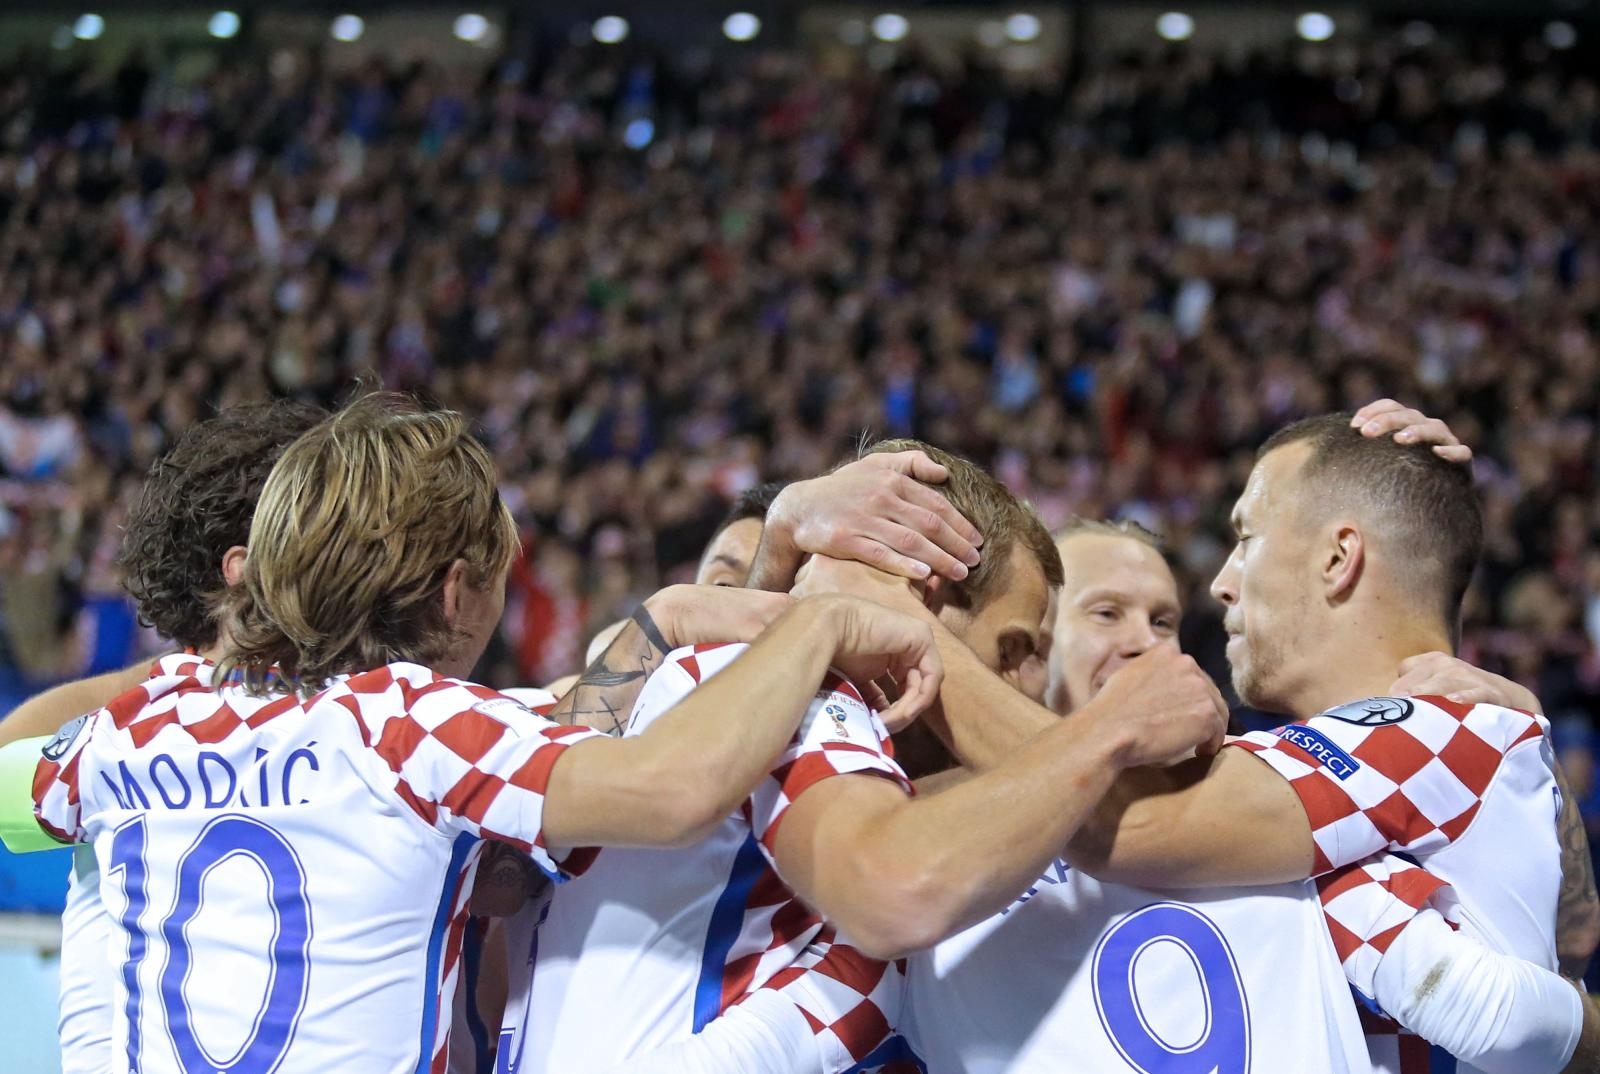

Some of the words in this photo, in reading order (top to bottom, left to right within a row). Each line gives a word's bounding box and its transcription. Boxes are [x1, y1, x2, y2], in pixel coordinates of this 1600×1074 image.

[100, 741, 319, 809] MODIĆ
[1280, 729, 1352, 776] RESPECT
[108, 813, 313, 1074] 10
[1091, 902, 1252, 1074] 9
